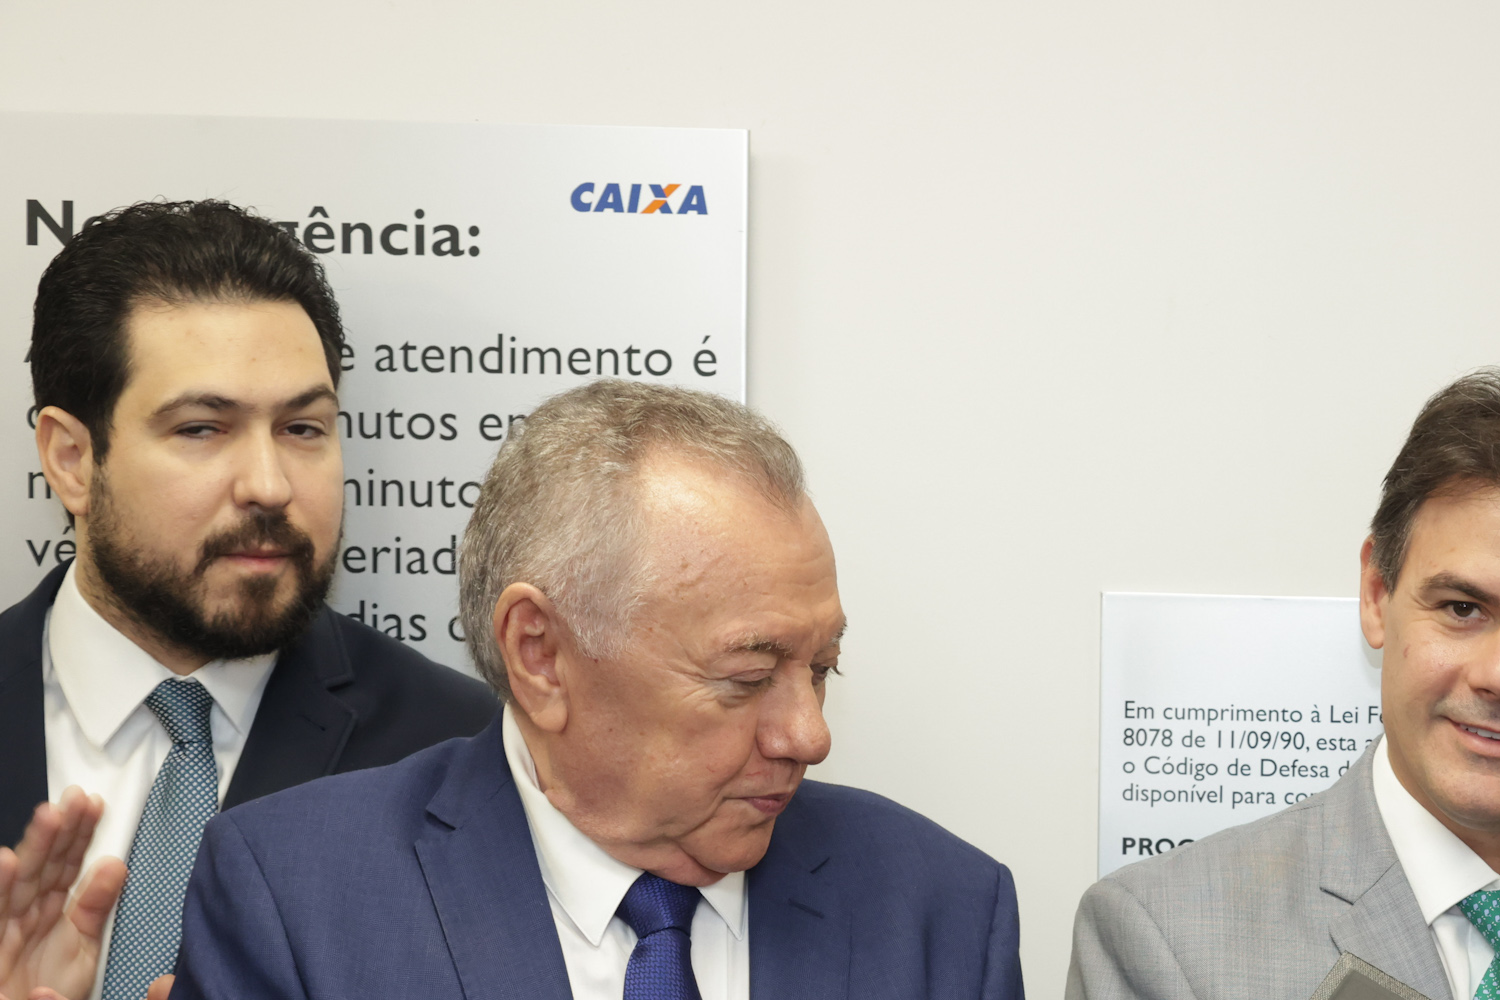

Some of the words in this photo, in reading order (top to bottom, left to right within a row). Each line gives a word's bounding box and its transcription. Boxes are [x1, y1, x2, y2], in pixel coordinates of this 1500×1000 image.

[570, 182, 708, 215] CAIXA
[277, 206, 481, 258] ência:
[374, 333, 673, 377] atendimento
[693, 335, 718, 377] é
[338, 409, 458, 441] nutos
[342, 535, 457, 575] eriad
[1124, 700, 1155, 720] Em
[1163, 704, 1303, 727] cumprimento
[1310, 704, 1321, 724] à
[1330, 705, 1358, 724] Lei
[1123, 728, 1173, 748] 8078
[1181, 729, 1206, 748] de
[1218, 731, 1310, 753] 11/09/90,
[1316, 737, 1357, 752] esta
[1122, 762, 1135, 774] o
[1144, 755, 1218, 781] Código
[1227, 758, 1251, 777] de
[1260, 758, 1330, 778] Defesa
[1122, 782, 1223, 808] disponível
[1232, 791, 1276, 809] para
[1284, 792, 1314, 805] co
